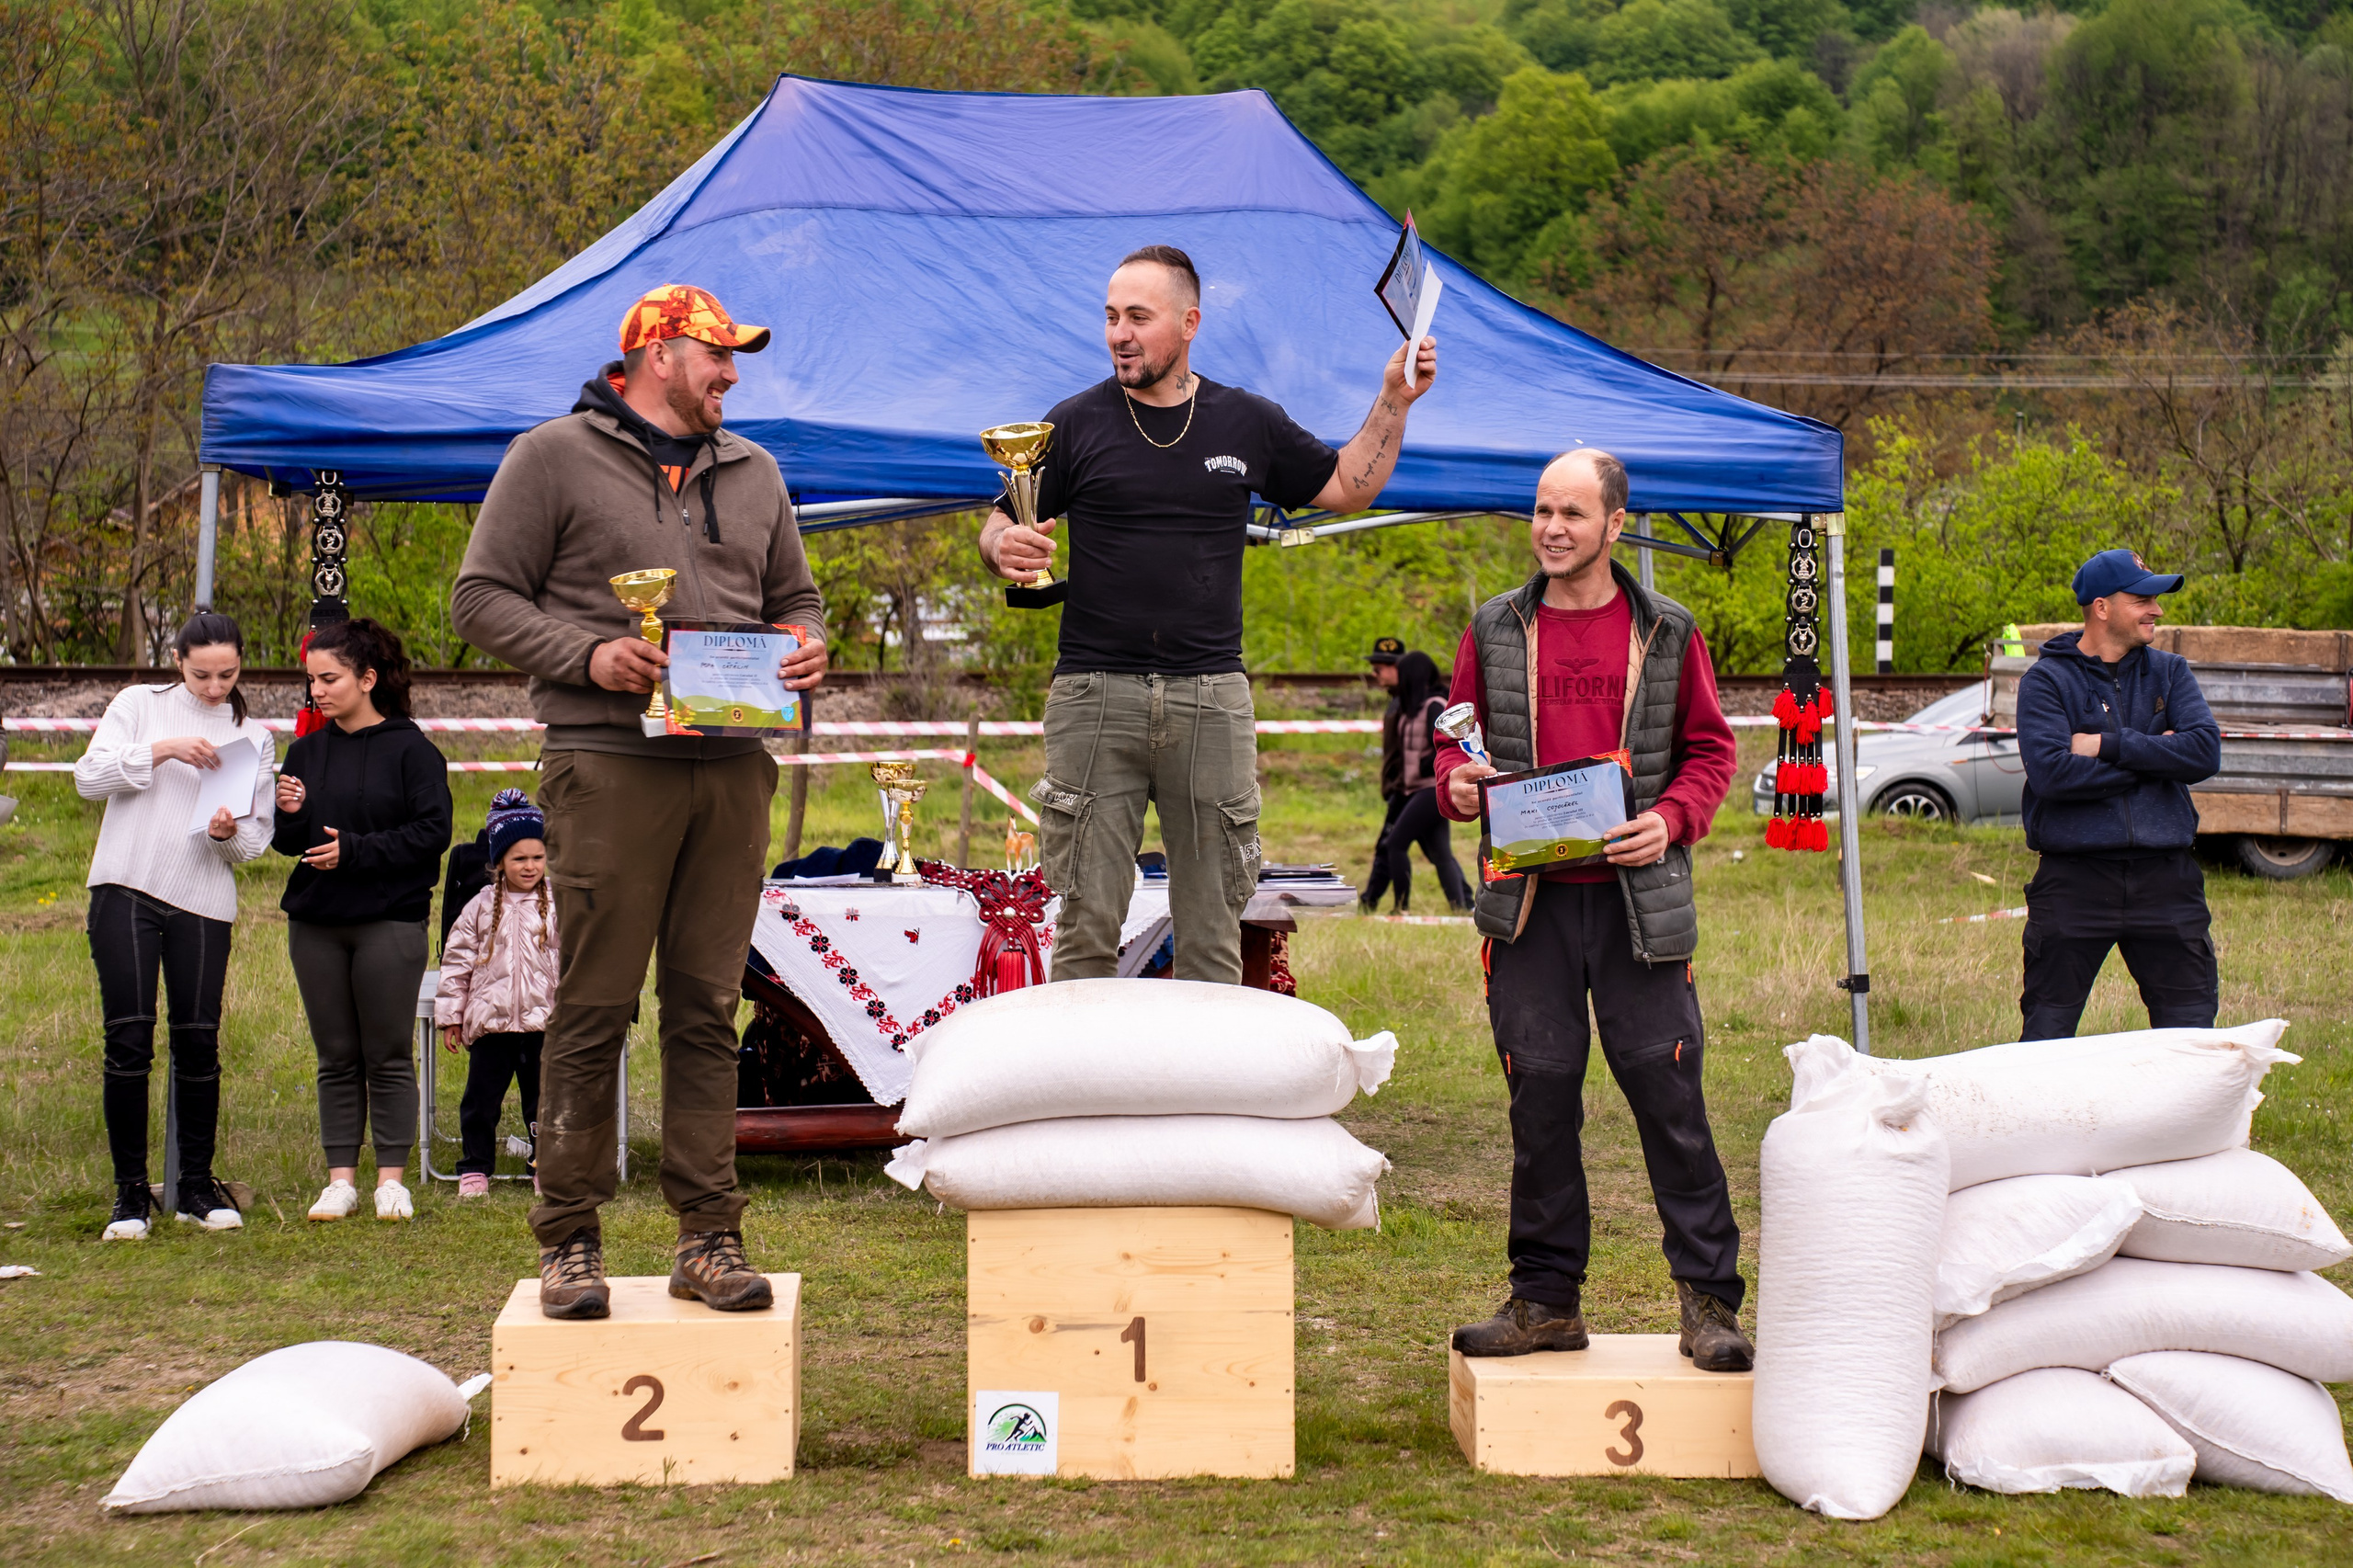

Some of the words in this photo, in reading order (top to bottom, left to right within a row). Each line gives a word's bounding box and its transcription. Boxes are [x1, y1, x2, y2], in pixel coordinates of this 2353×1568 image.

[1204, 455, 1247, 477] TOMORROW
[704, 635, 767, 649] DIPLOMĂ
[1523, 770, 1588, 794] DIPLOMĂ
[1120, 1316, 1146, 1382] 1
[621, 1375, 665, 1442] 2
[1604, 1400, 1644, 1467] 3
[985, 1443, 1005, 1451] PRO
[1005, 1443, 1045, 1451] ATLETIC
